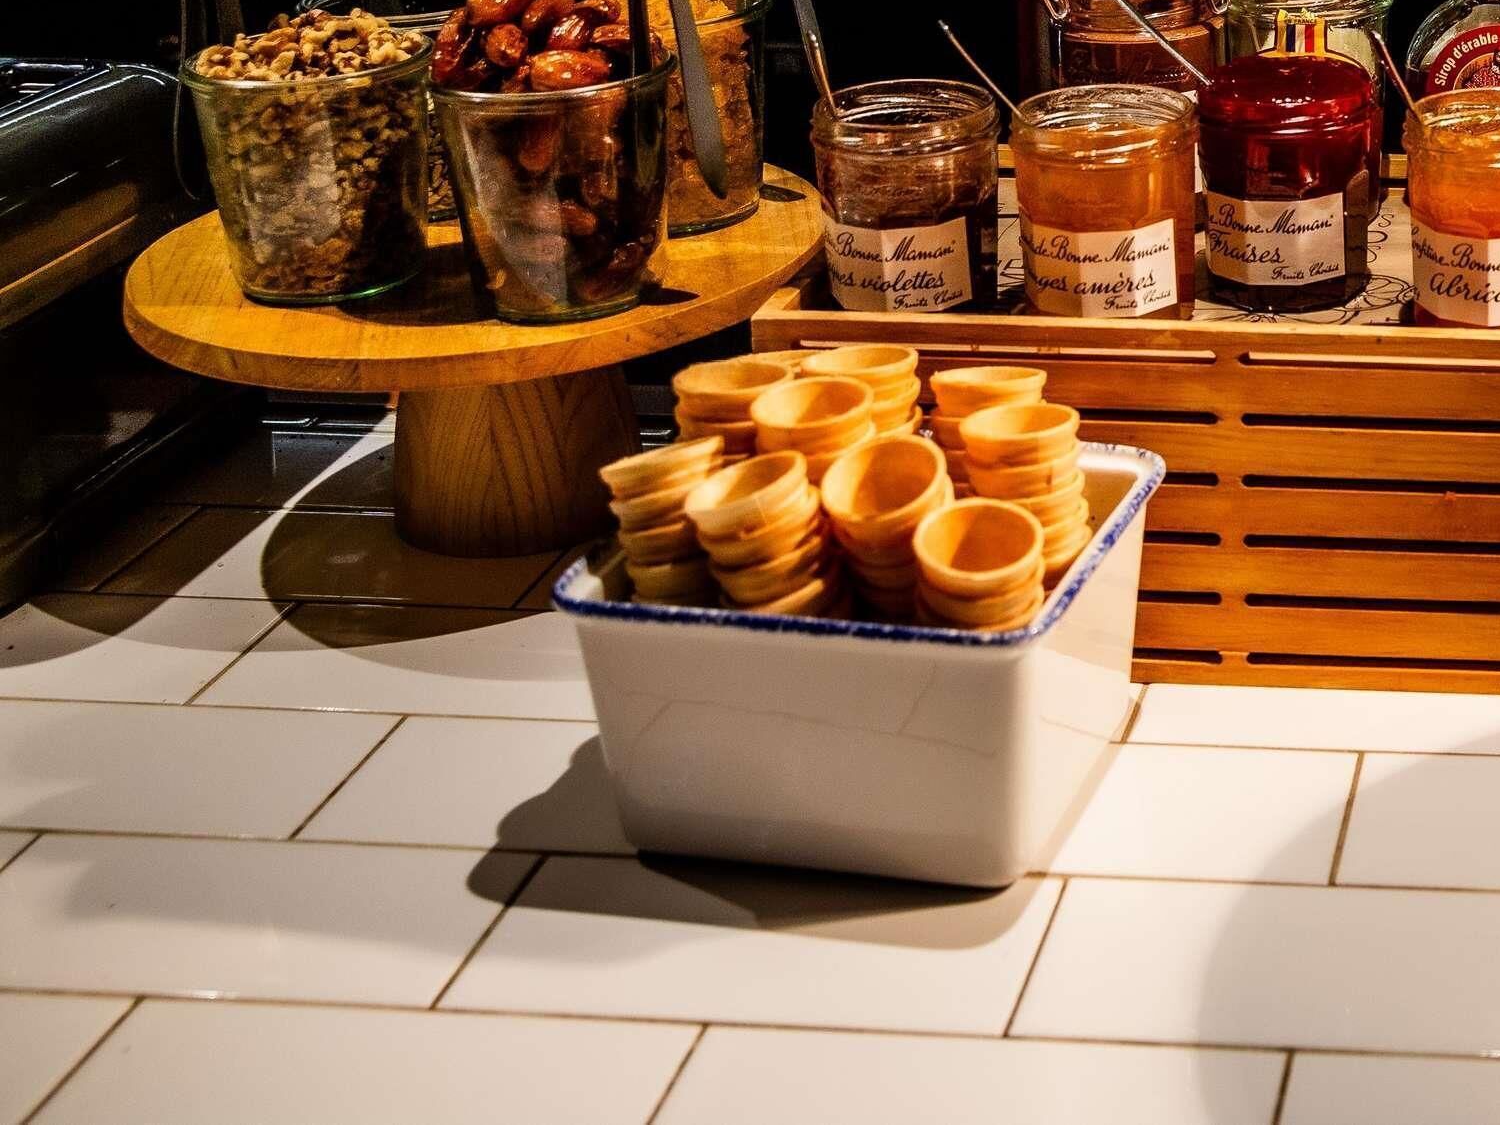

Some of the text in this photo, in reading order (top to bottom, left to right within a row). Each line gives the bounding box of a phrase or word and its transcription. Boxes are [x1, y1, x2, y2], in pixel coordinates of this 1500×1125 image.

[1435, 56, 1457, 87] Sirop
[1453, 32, 1499, 60] d'érable
[1216, 203, 1265, 234] Bonne
[1265, 209, 1331, 235] Maman
[837, 231, 883, 262] Bonne
[884, 235, 954, 263] Maman
[1050, 235, 1103, 264] Bonne
[1104, 235, 1169, 263] Maman
[1208, 229, 1285, 265] Fraises
[860, 269, 945, 293] violettes
[1073, 269, 1157, 295] amères
[1271, 266, 1305, 281] Fruits
[893, 293, 929, 310] Fruits
[1104, 295, 1138, 311] Fruits
